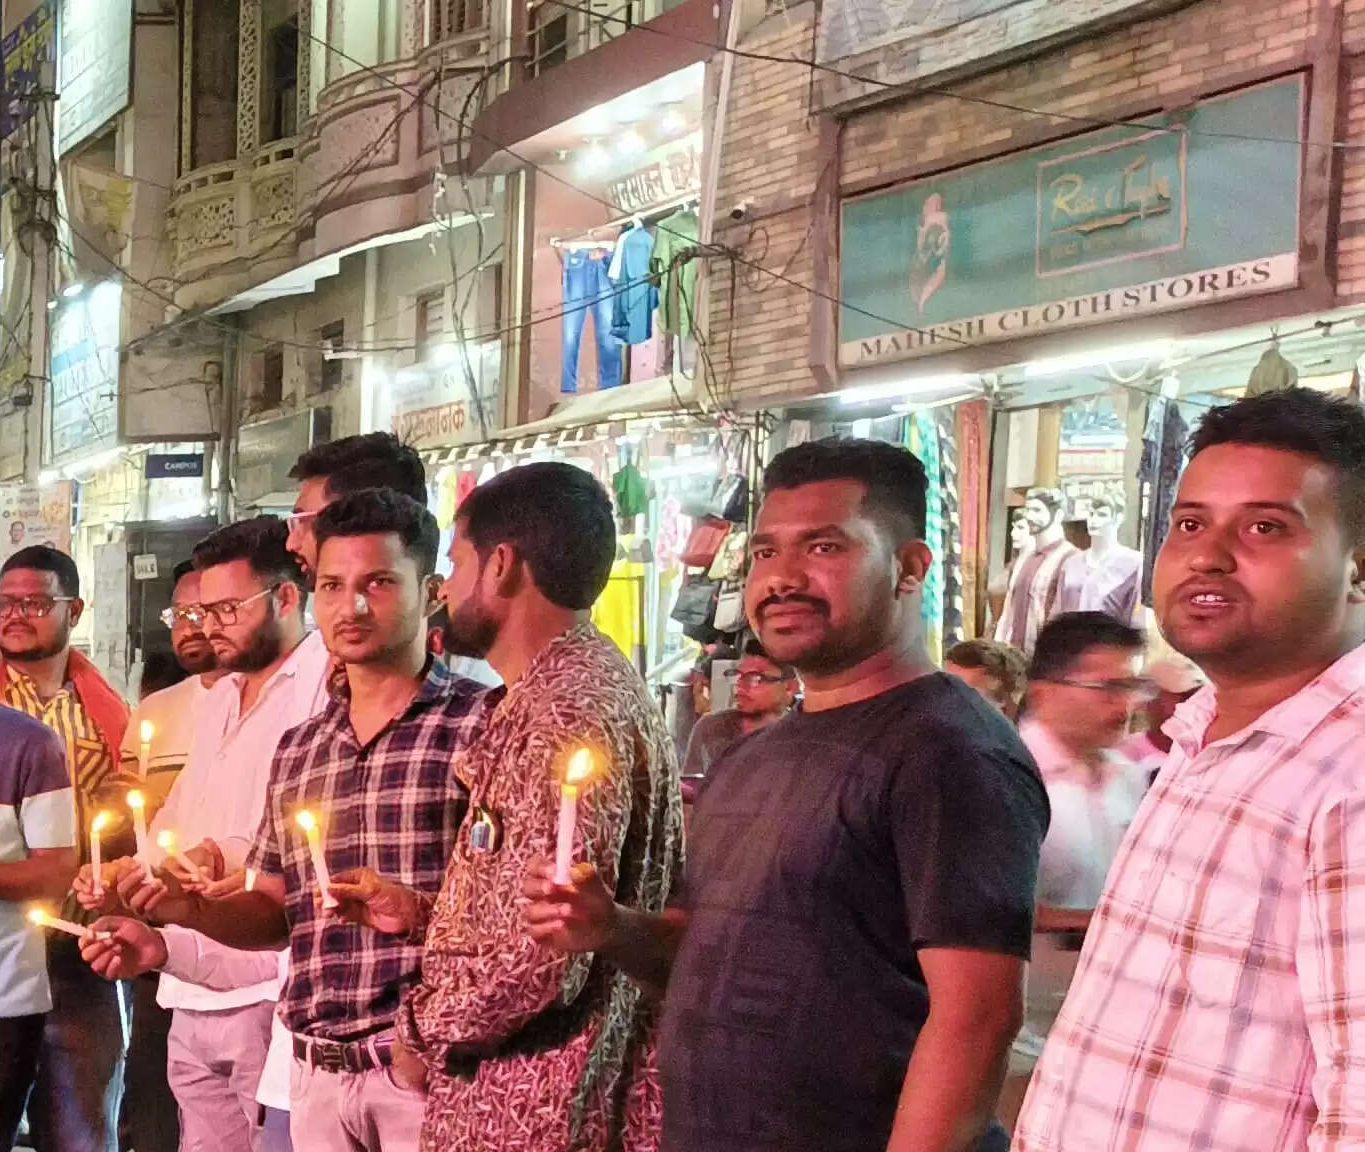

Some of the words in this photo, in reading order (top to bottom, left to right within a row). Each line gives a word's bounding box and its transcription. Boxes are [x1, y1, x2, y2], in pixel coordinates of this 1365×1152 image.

[859, 318, 986, 361] MAHESH
[997, 294, 1113, 333] CLOTH
[1121, 259, 1271, 308] STORES
